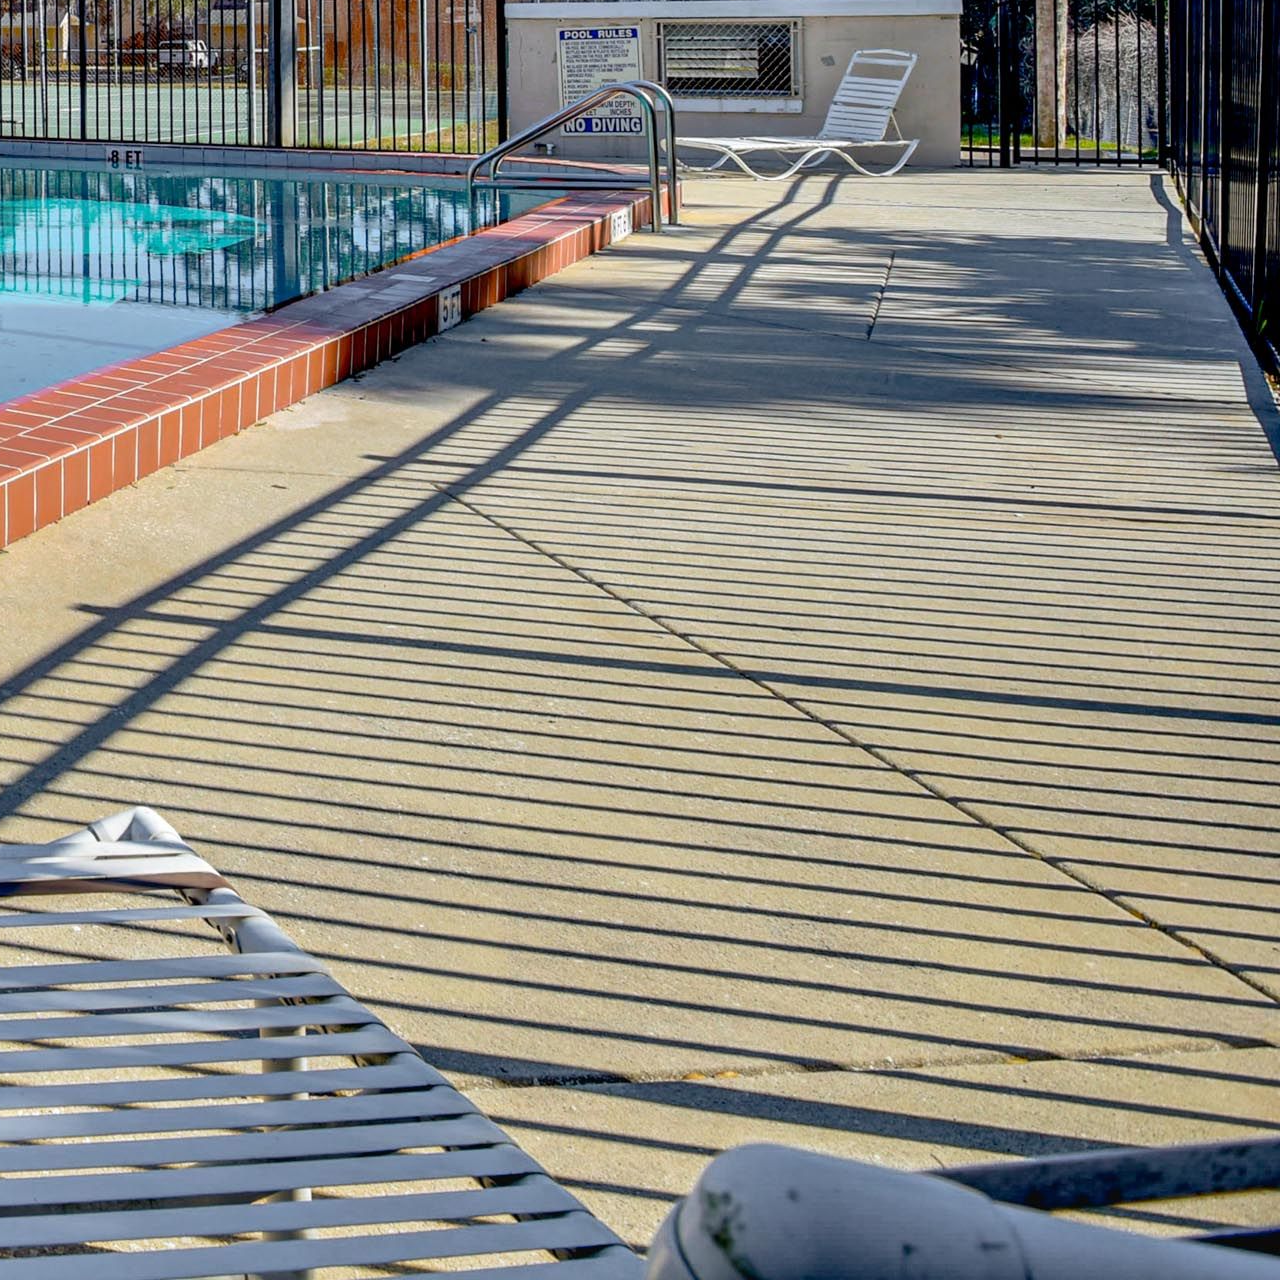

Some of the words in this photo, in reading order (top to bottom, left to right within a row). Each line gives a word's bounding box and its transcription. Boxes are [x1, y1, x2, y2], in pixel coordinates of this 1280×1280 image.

[564, 30, 593, 40] POOL
[597, 28, 633, 39] RULES
[565, 118, 586, 132] NO
[591, 118, 641, 132] DIVING
